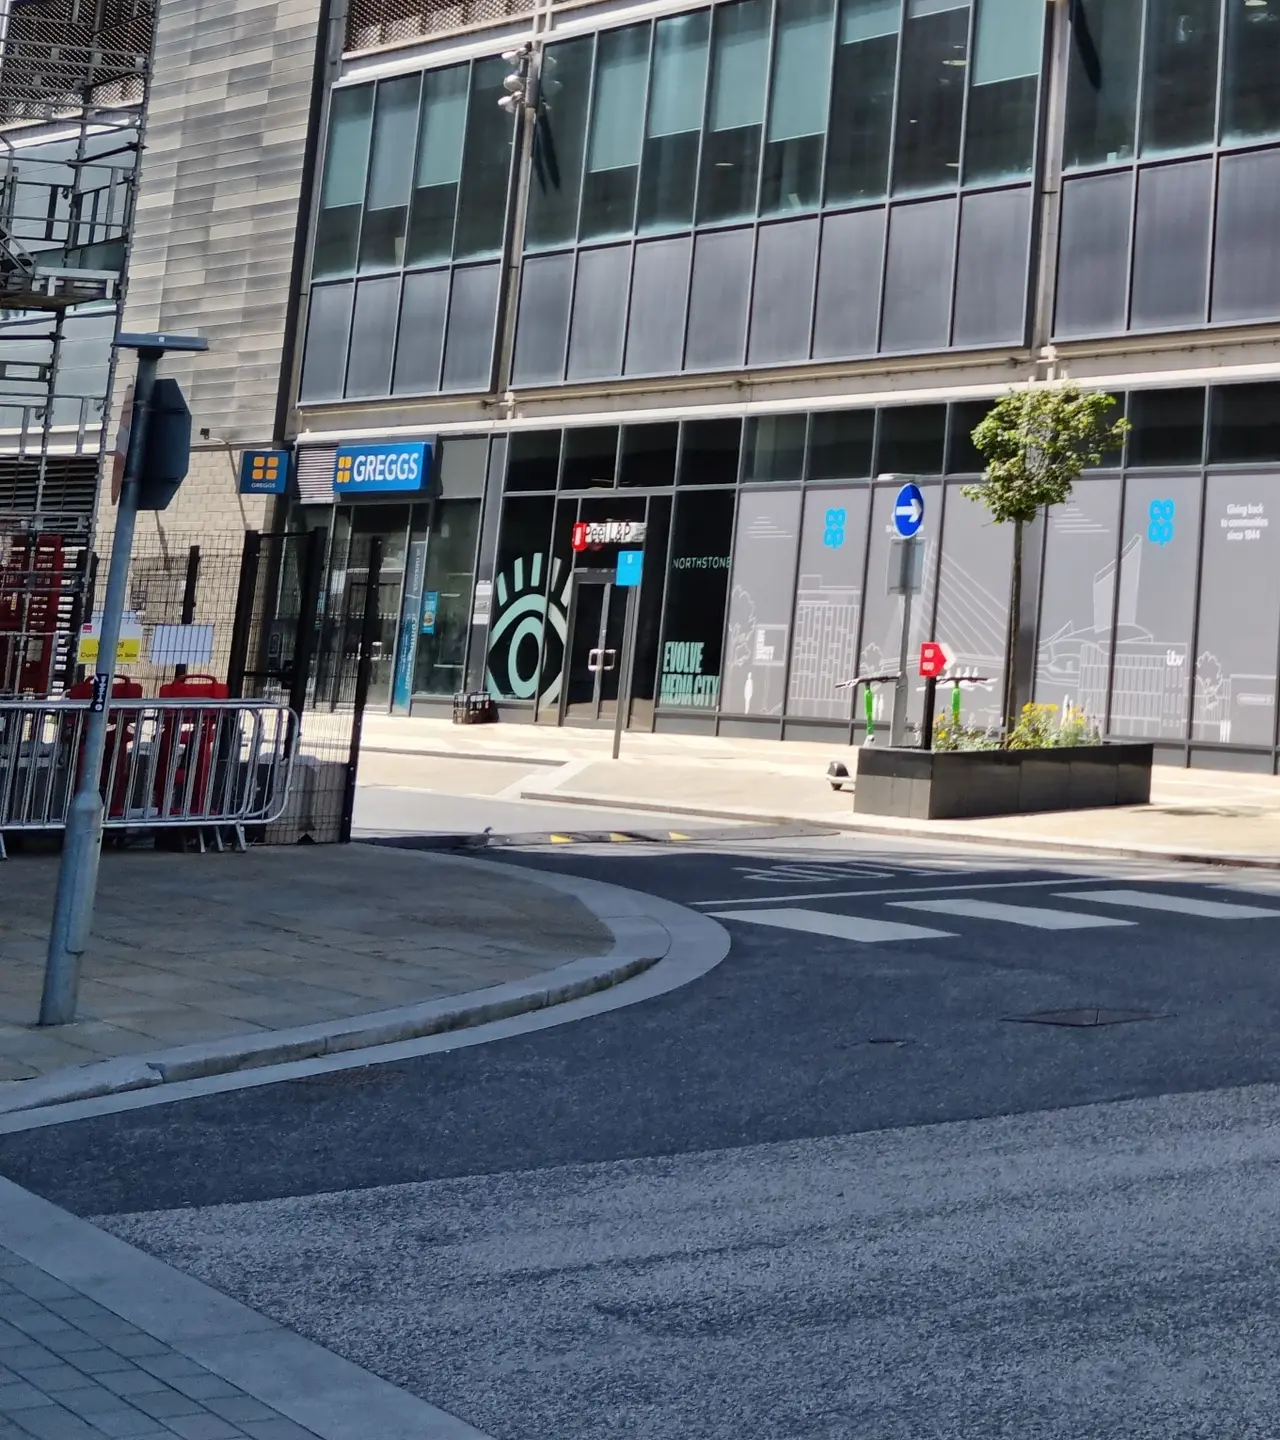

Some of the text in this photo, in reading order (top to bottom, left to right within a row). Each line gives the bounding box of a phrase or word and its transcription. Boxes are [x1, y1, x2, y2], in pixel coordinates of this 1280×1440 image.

[353, 452, 420, 483] GREGGS
[1227, 503, 1263, 516] Giving back
[1221, 517, 1268, 528] to communities
[584, 523, 608, 542] Peel
[1227, 529, 1260, 540] since 1844
[672, 556, 732, 569] NORTHSTONE
[662, 641, 705, 674] EVOLVE
[1166, 649, 1185, 666] itv
